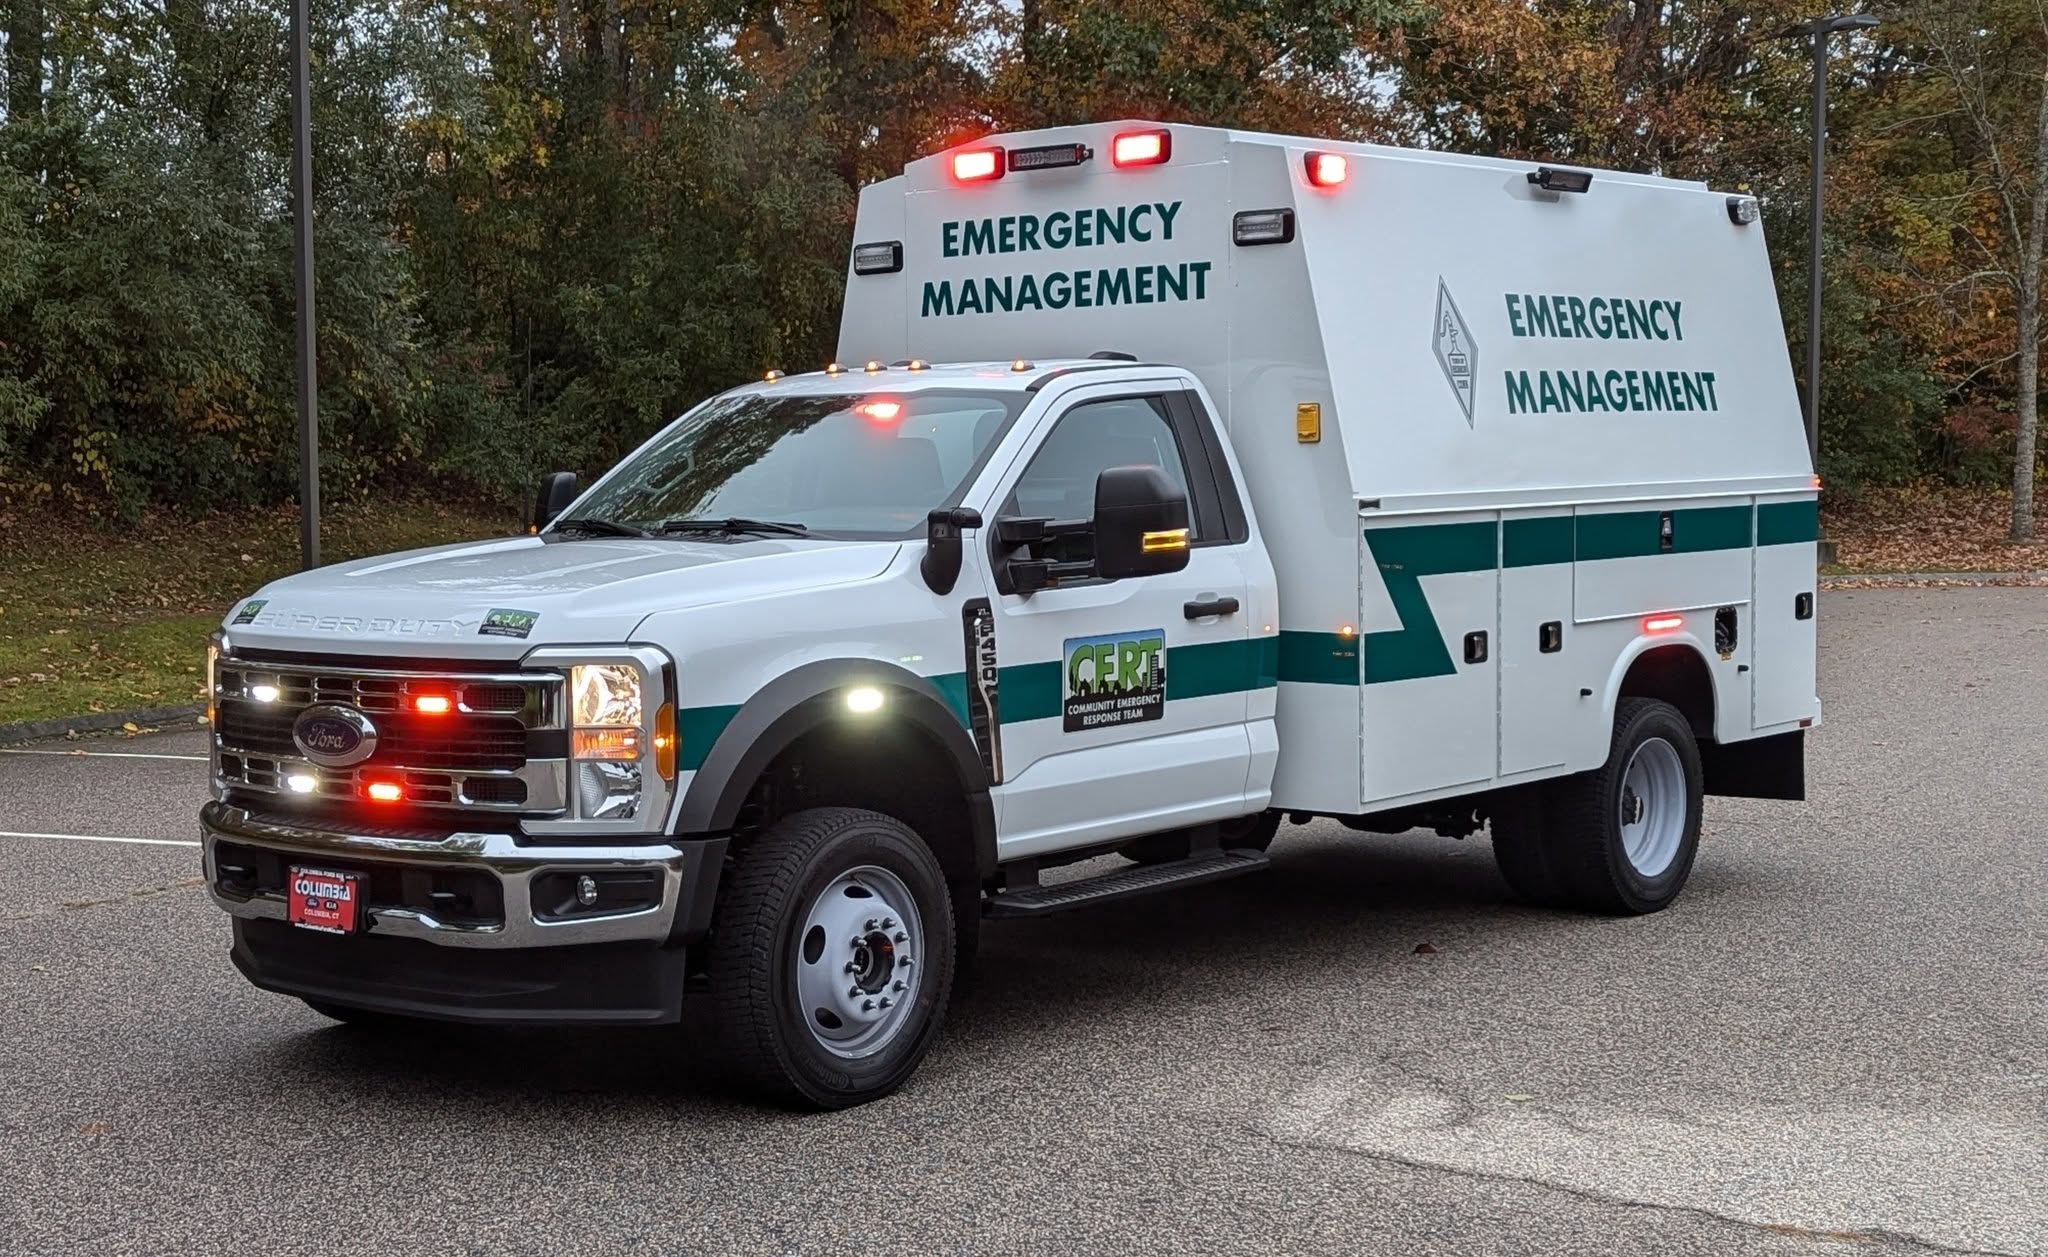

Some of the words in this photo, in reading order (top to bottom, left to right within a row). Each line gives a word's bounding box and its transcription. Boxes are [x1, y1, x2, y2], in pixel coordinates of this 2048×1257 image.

[942, 200, 1183, 258] EMERGENCY
[921, 261, 1212, 318] MANAGEMENT
[1504, 293, 1683, 341] EMERGENCY
[1504, 369, 1719, 415] MANAGEMENT
[251, 610, 363, 633] SUPER
[365, 616, 481, 637] DUTY
[1069, 638, 1162, 694] CERT
[1068, 700, 1115, 715] COMMUNITY
[1117, 694, 1160, 709] EMERGENCY
[1083, 711, 1121, 725] RESPONSE
[1123, 708, 1144, 720] TEAM
[307, 722, 345, 749] Ford
